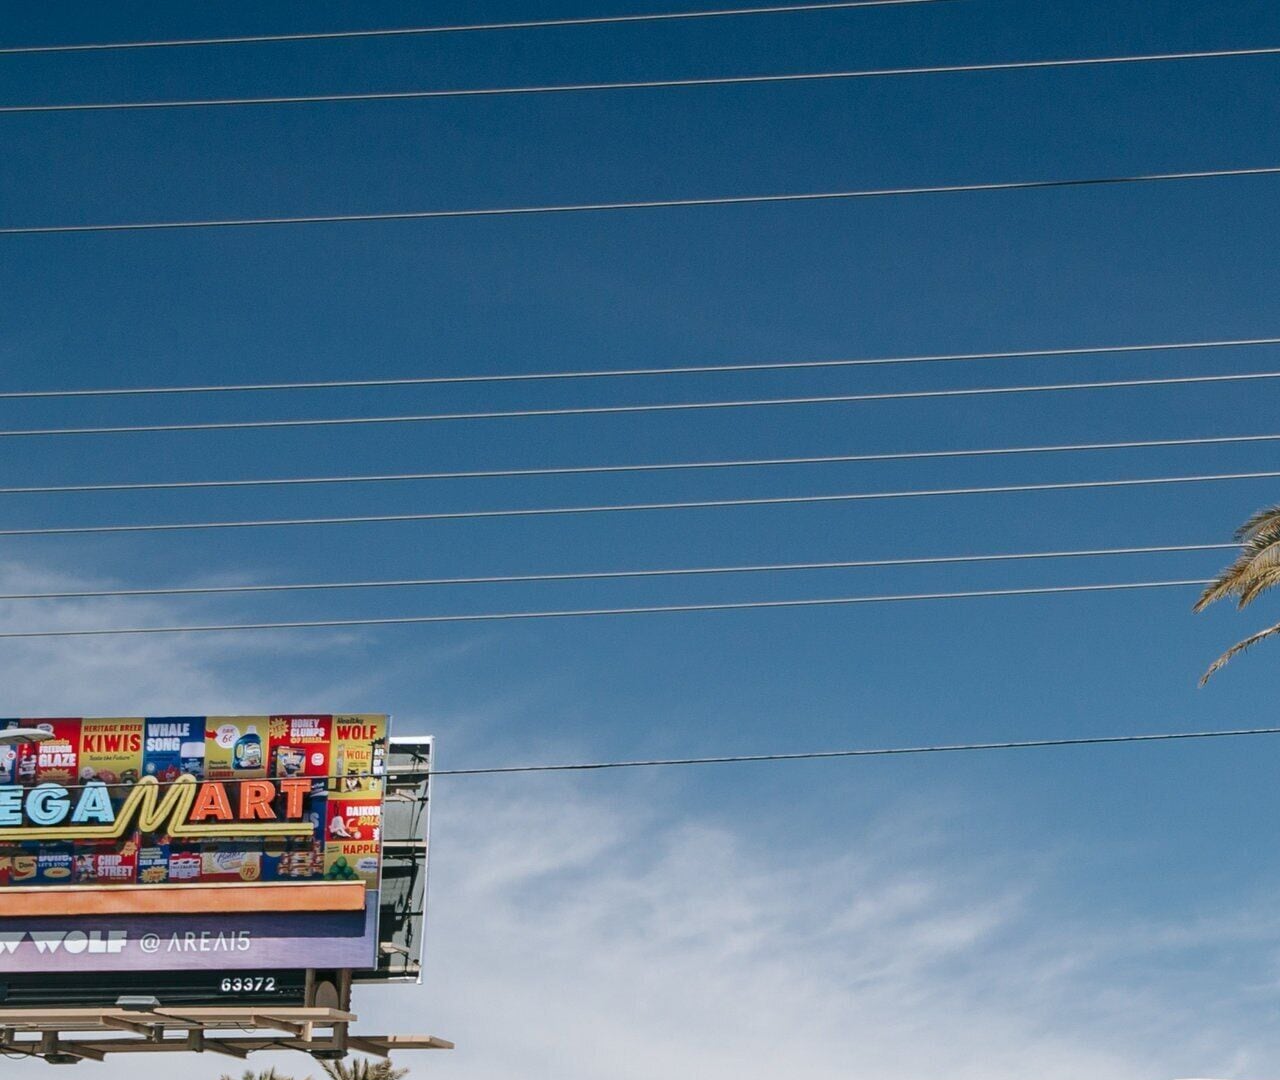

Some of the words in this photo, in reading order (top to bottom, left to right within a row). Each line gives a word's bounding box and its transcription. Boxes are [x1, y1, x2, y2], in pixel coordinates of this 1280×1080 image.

[83, 724, 118, 733] HERITAGE
[119, 724, 143, 732] BREED
[147, 723, 191, 737] WHALE
[290, 727, 326, 738] CLUMPS
[336, 725, 377, 740] WOLF
[83, 734, 141, 753] KIWIS
[146, 737, 181, 752] SONG
[38, 753, 77, 767] GLAZE
[346, 750, 371, 760] WOLF
[98, 854, 123, 866] CHIP
[97, 866, 134, 877] STREET
[29, 930, 128, 954] WOLF
[140, 932, 161, 953] @
[221, 977, 276, 992] 63372
